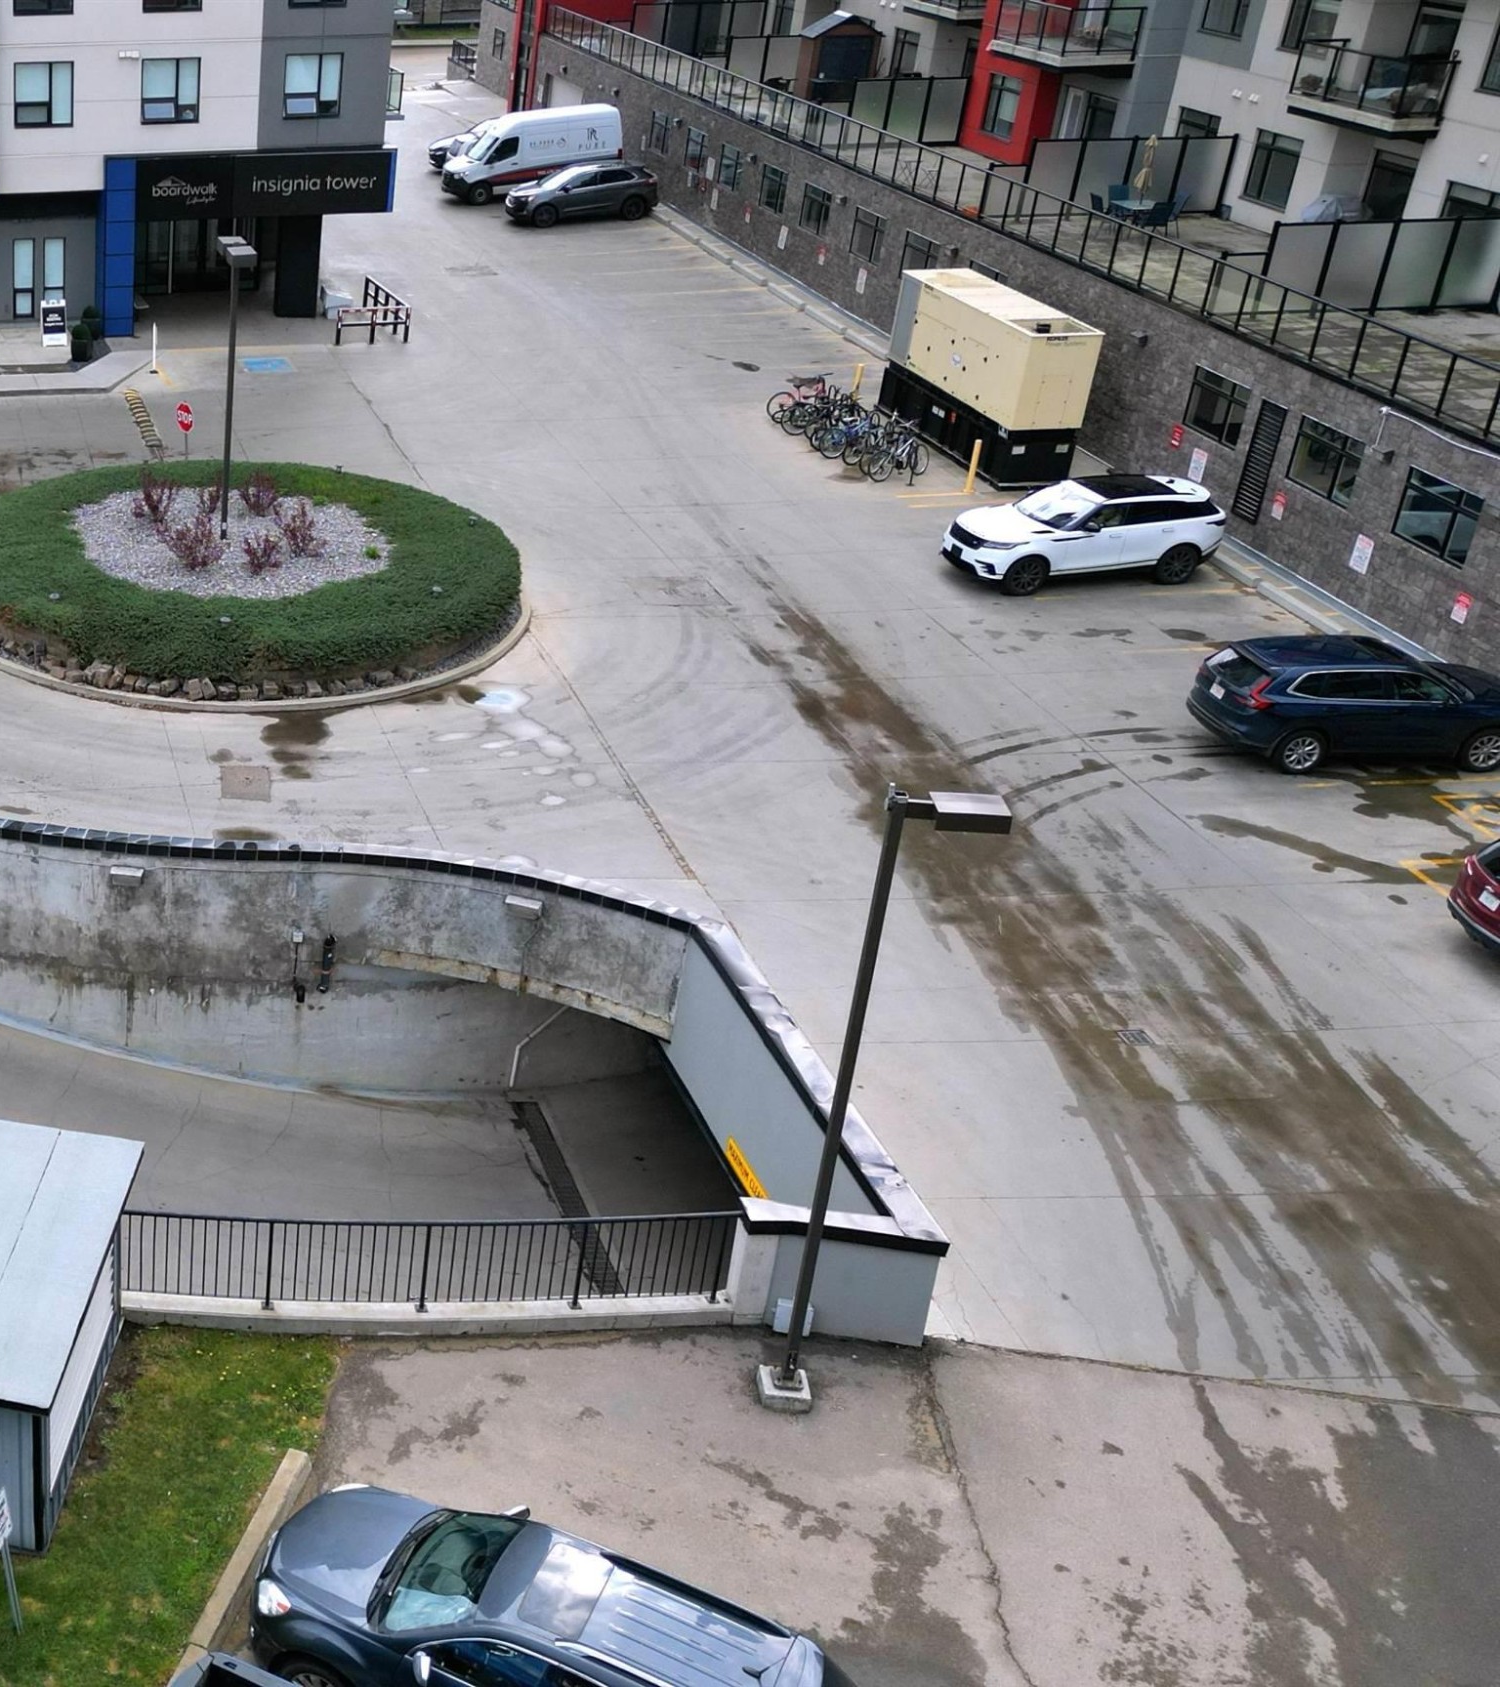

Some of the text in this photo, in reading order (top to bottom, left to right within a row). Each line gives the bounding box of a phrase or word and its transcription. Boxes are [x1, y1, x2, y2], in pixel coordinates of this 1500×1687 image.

[151, 182, 218, 197] boardwalk
[252, 174, 377, 196] insignia tower
[177, 410, 192, 424] STOP
